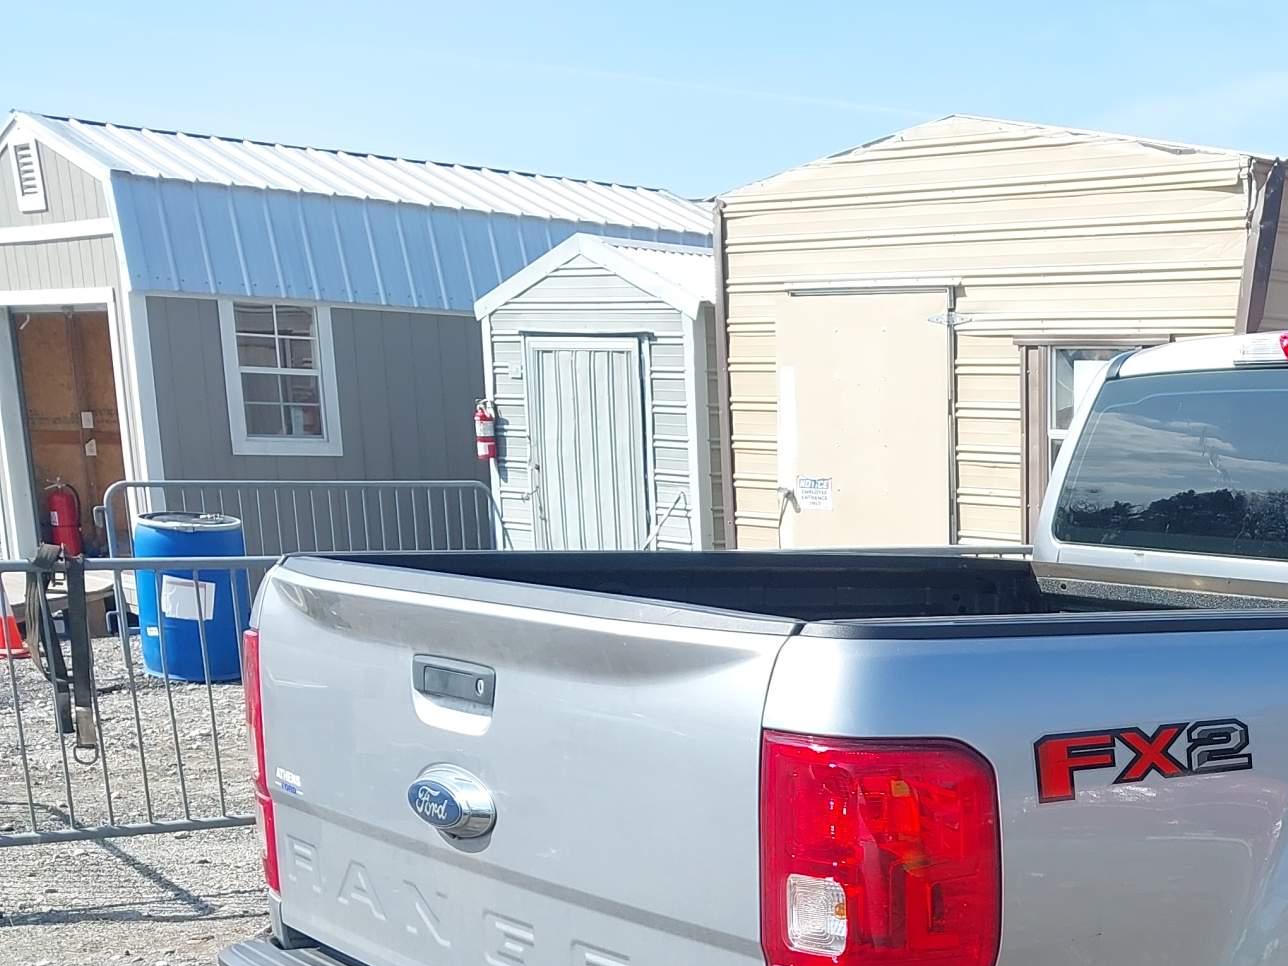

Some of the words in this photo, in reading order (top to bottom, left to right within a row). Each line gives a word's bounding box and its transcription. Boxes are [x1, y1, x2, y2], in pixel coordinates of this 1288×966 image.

[799, 479, 829, 489] NOTICE
[1033, 718, 1252, 804] FX2
[415, 785, 449, 820] Ford
